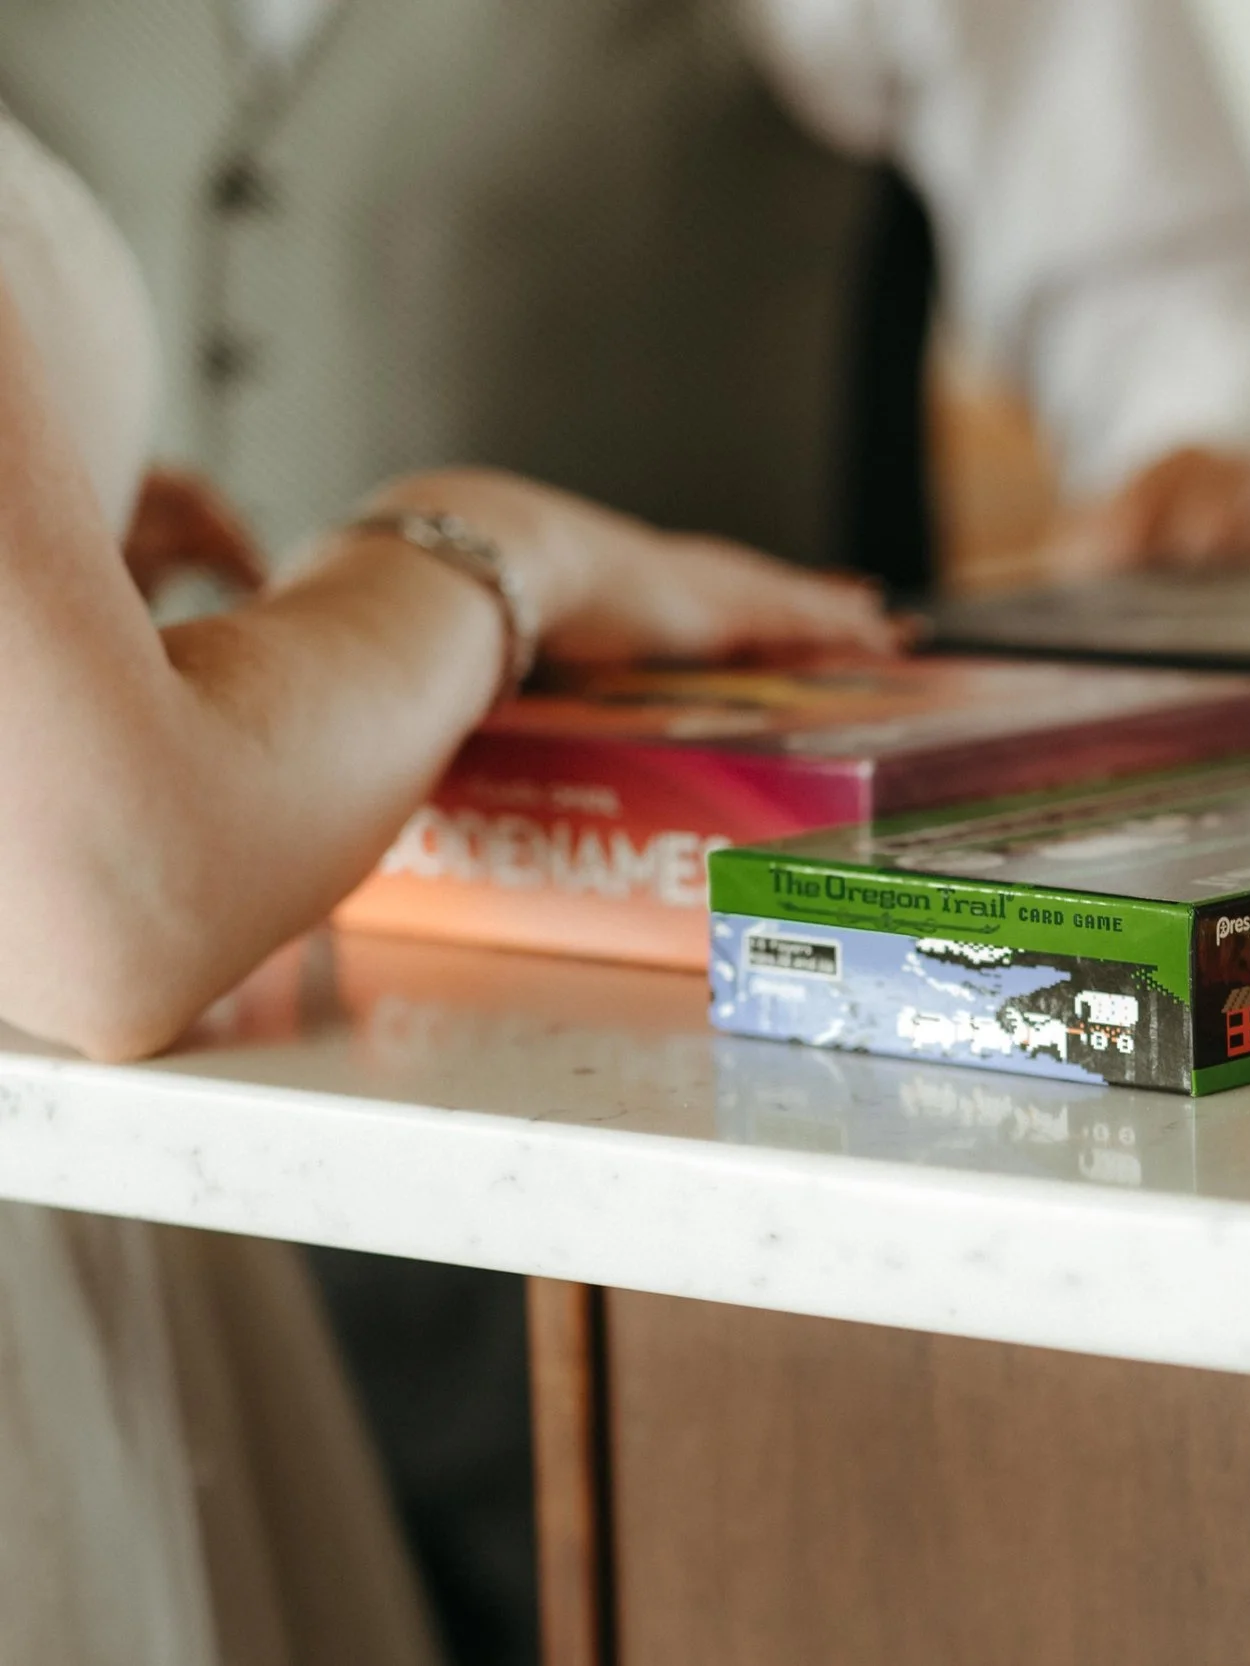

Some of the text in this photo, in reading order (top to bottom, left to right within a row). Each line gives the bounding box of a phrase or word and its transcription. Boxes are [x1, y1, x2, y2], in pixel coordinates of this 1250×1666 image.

[382, 803, 733, 908] ODENAME
[769, 868, 820, 895] The
[825, 874, 931, 911] Oregon
[1018, 907, 1123, 933] CARD GAME
